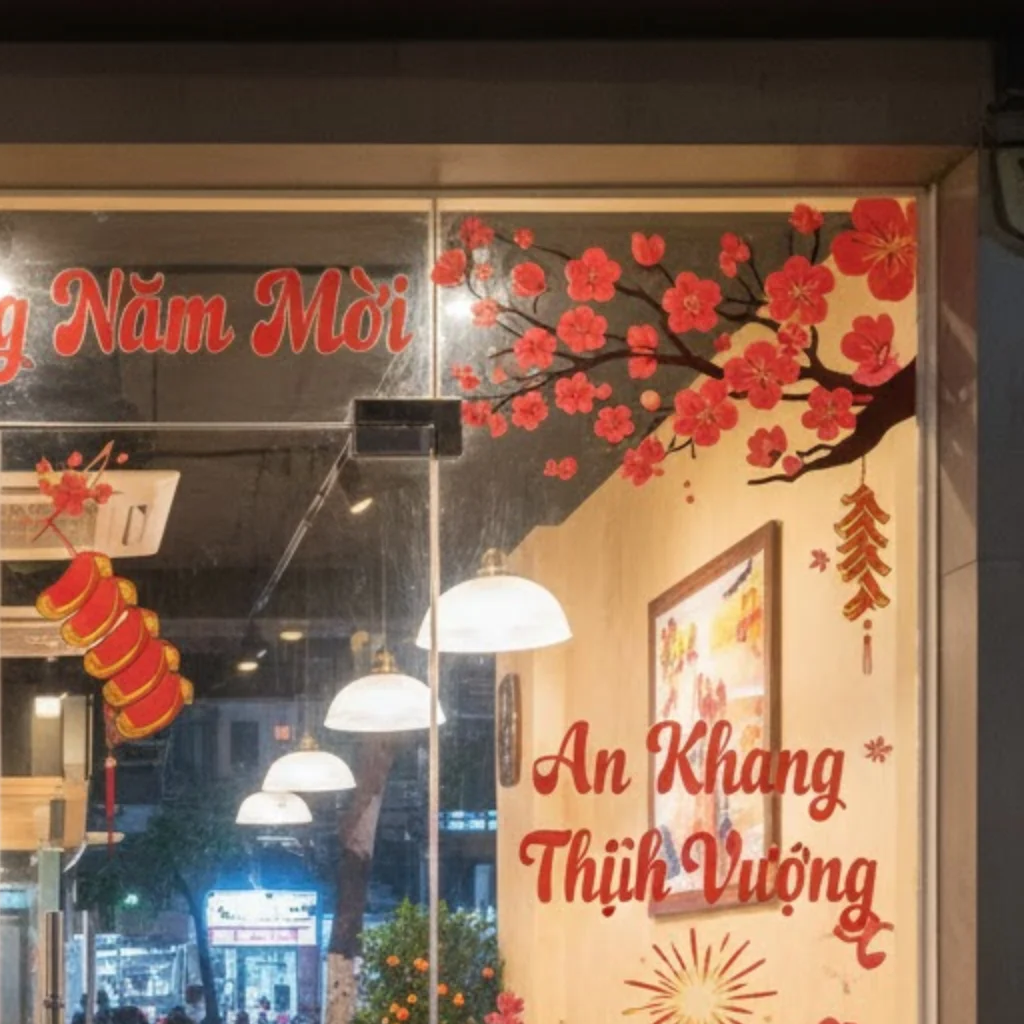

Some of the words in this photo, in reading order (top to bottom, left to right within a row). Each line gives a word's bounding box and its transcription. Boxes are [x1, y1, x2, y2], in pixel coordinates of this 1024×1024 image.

[51, 267, 235, 358] Năm
[532, 719, 632, 796] An
[645, 719, 847, 822] Khang
